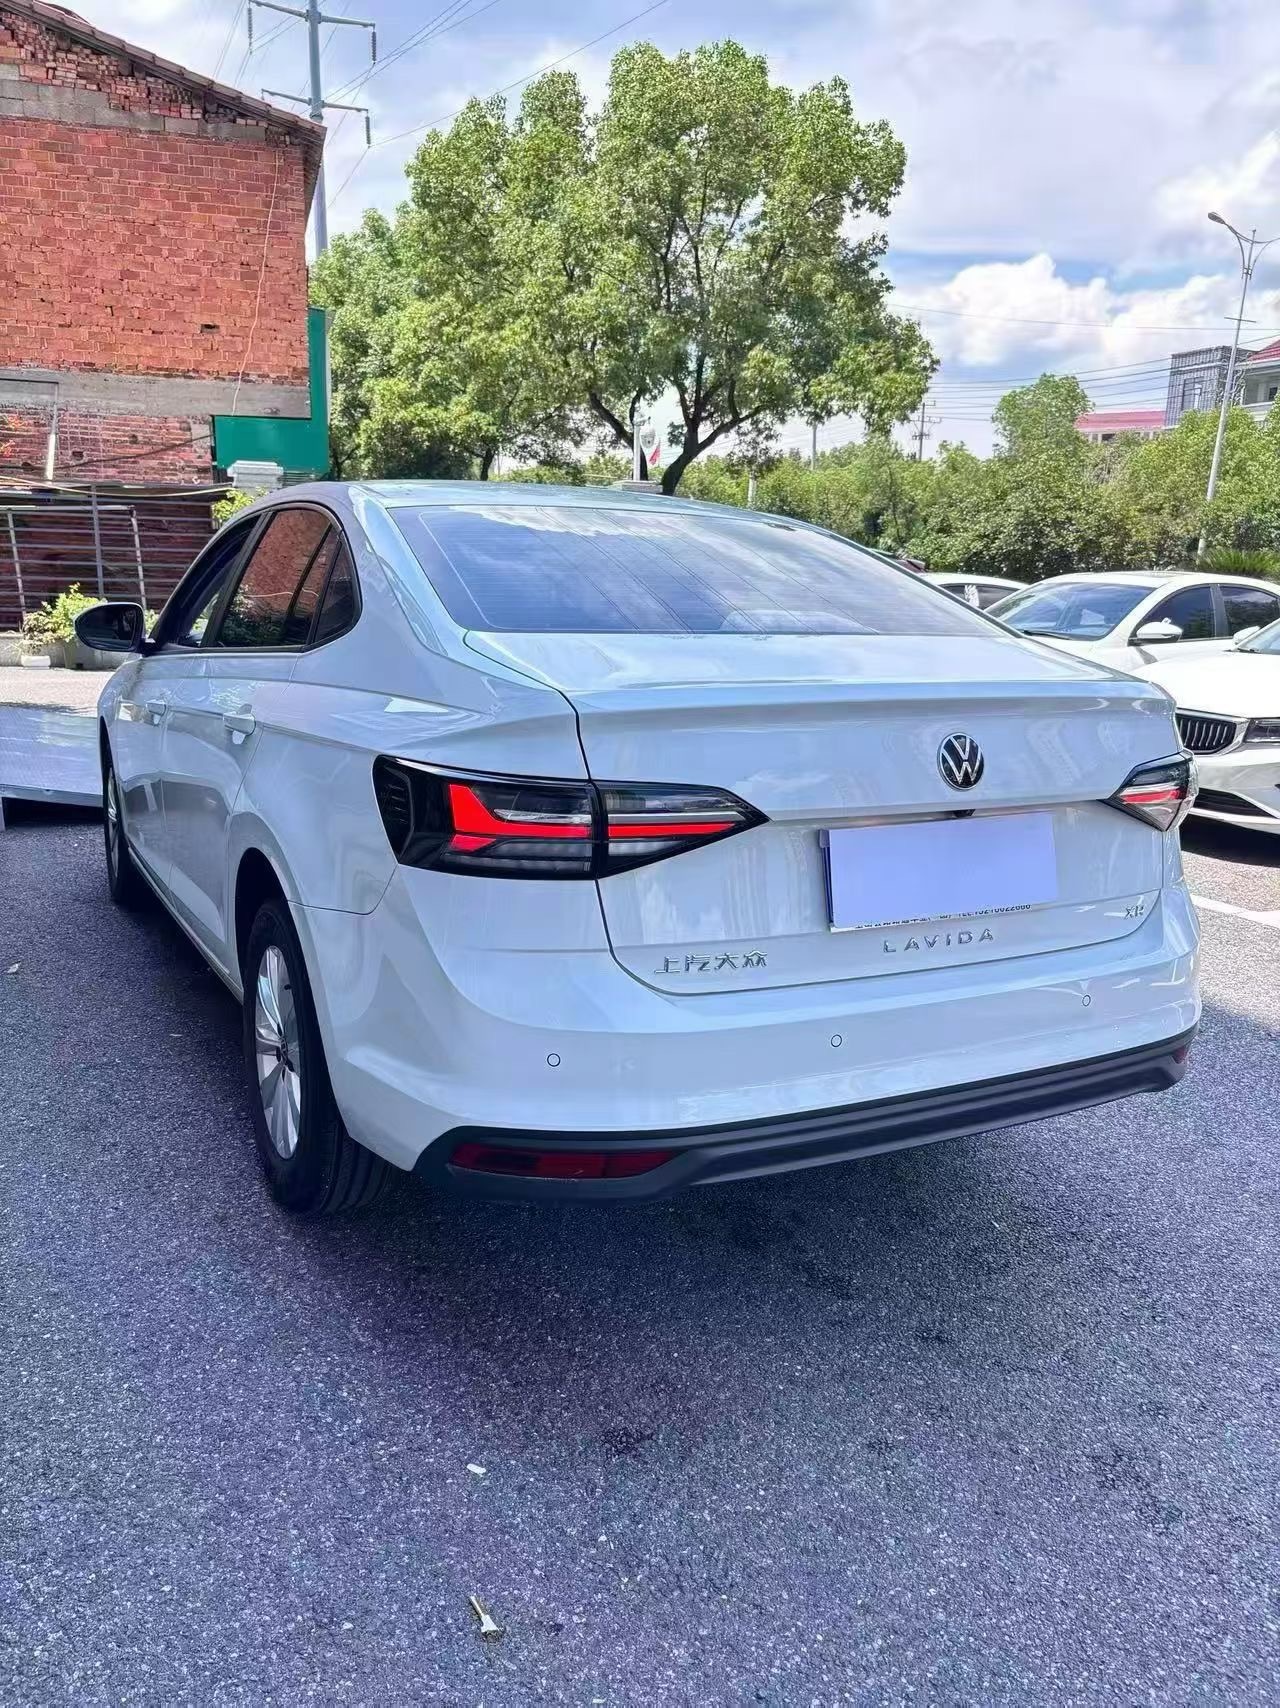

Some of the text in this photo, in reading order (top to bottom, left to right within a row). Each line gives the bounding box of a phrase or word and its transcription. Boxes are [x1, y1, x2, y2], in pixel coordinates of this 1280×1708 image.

[939, 734, 983, 787] VW
[882, 928, 995, 953] LAVIDA
[654, 950, 768, 974] 上汽大众
